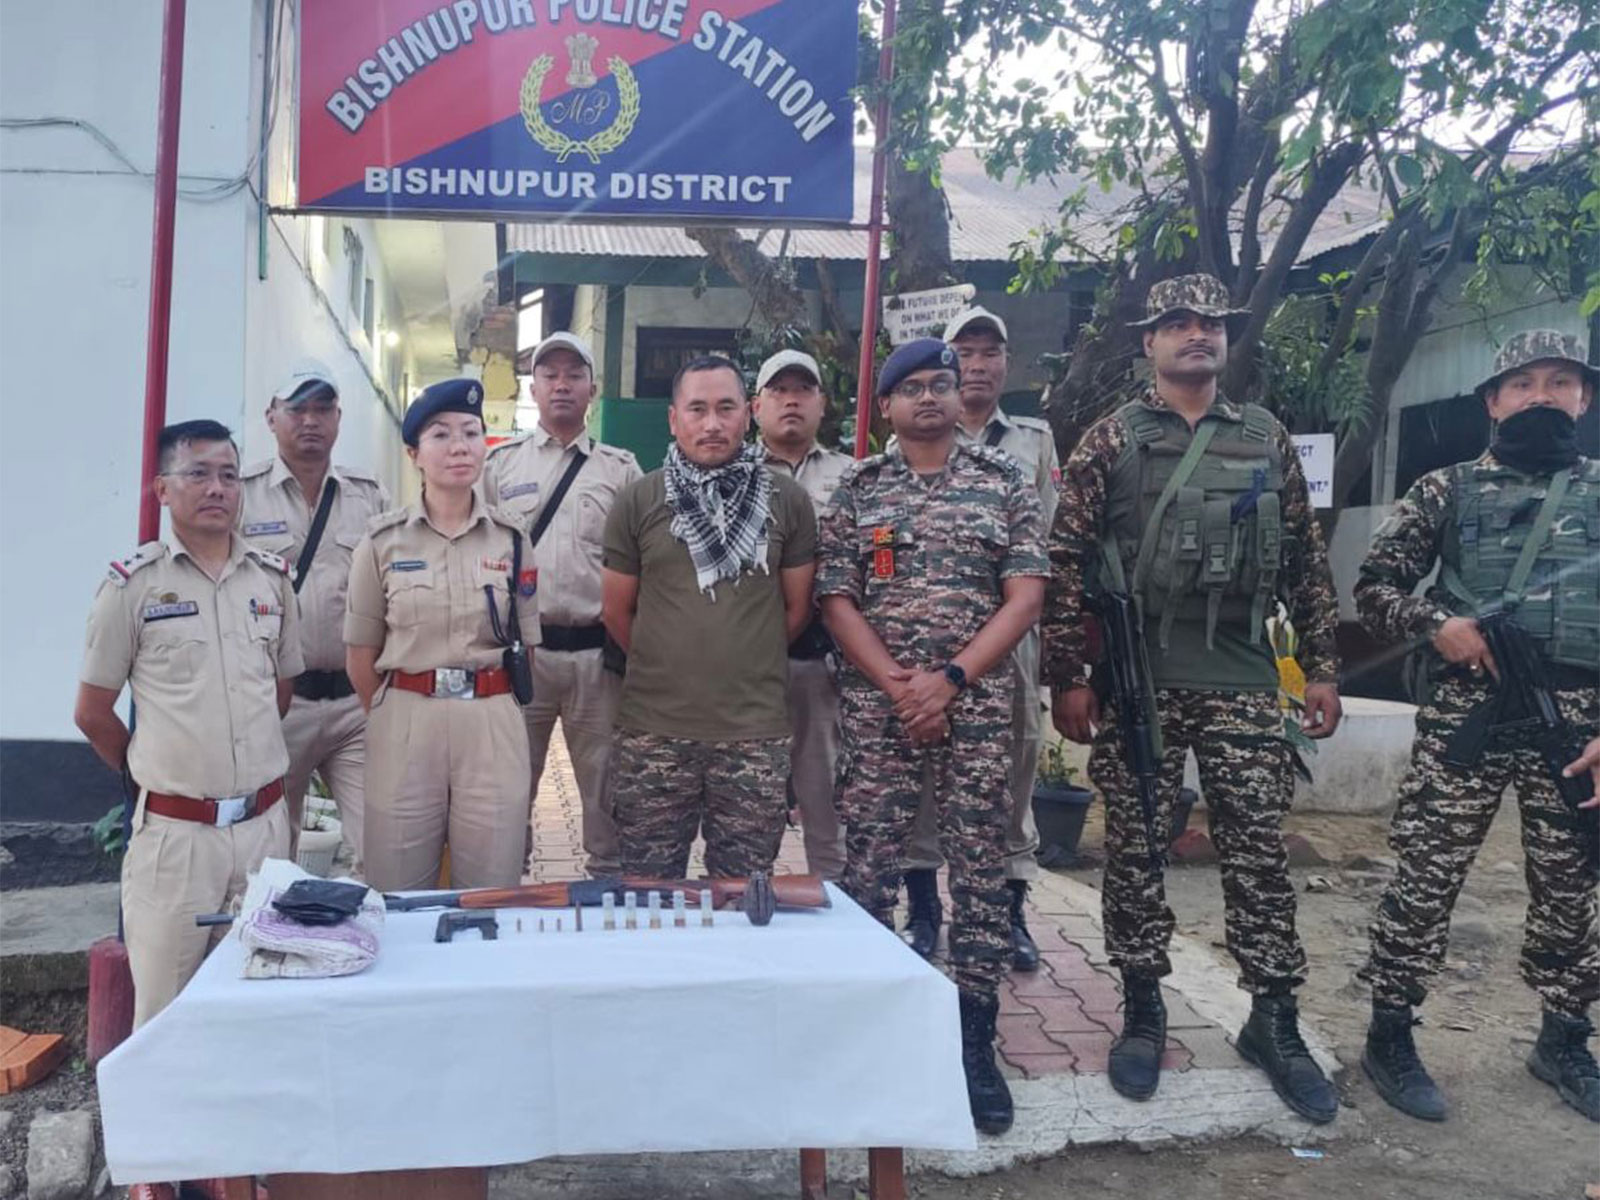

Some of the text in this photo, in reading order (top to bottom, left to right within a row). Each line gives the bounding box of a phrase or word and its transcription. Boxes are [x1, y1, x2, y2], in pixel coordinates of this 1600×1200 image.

[325, 0, 836, 142] BISHNUPUR POLICE STATION
[364, 166, 792, 203] BISHNUPUR DISTRICT
[901, 313, 912, 325] ON
[914, 309, 935, 322] WHAT
